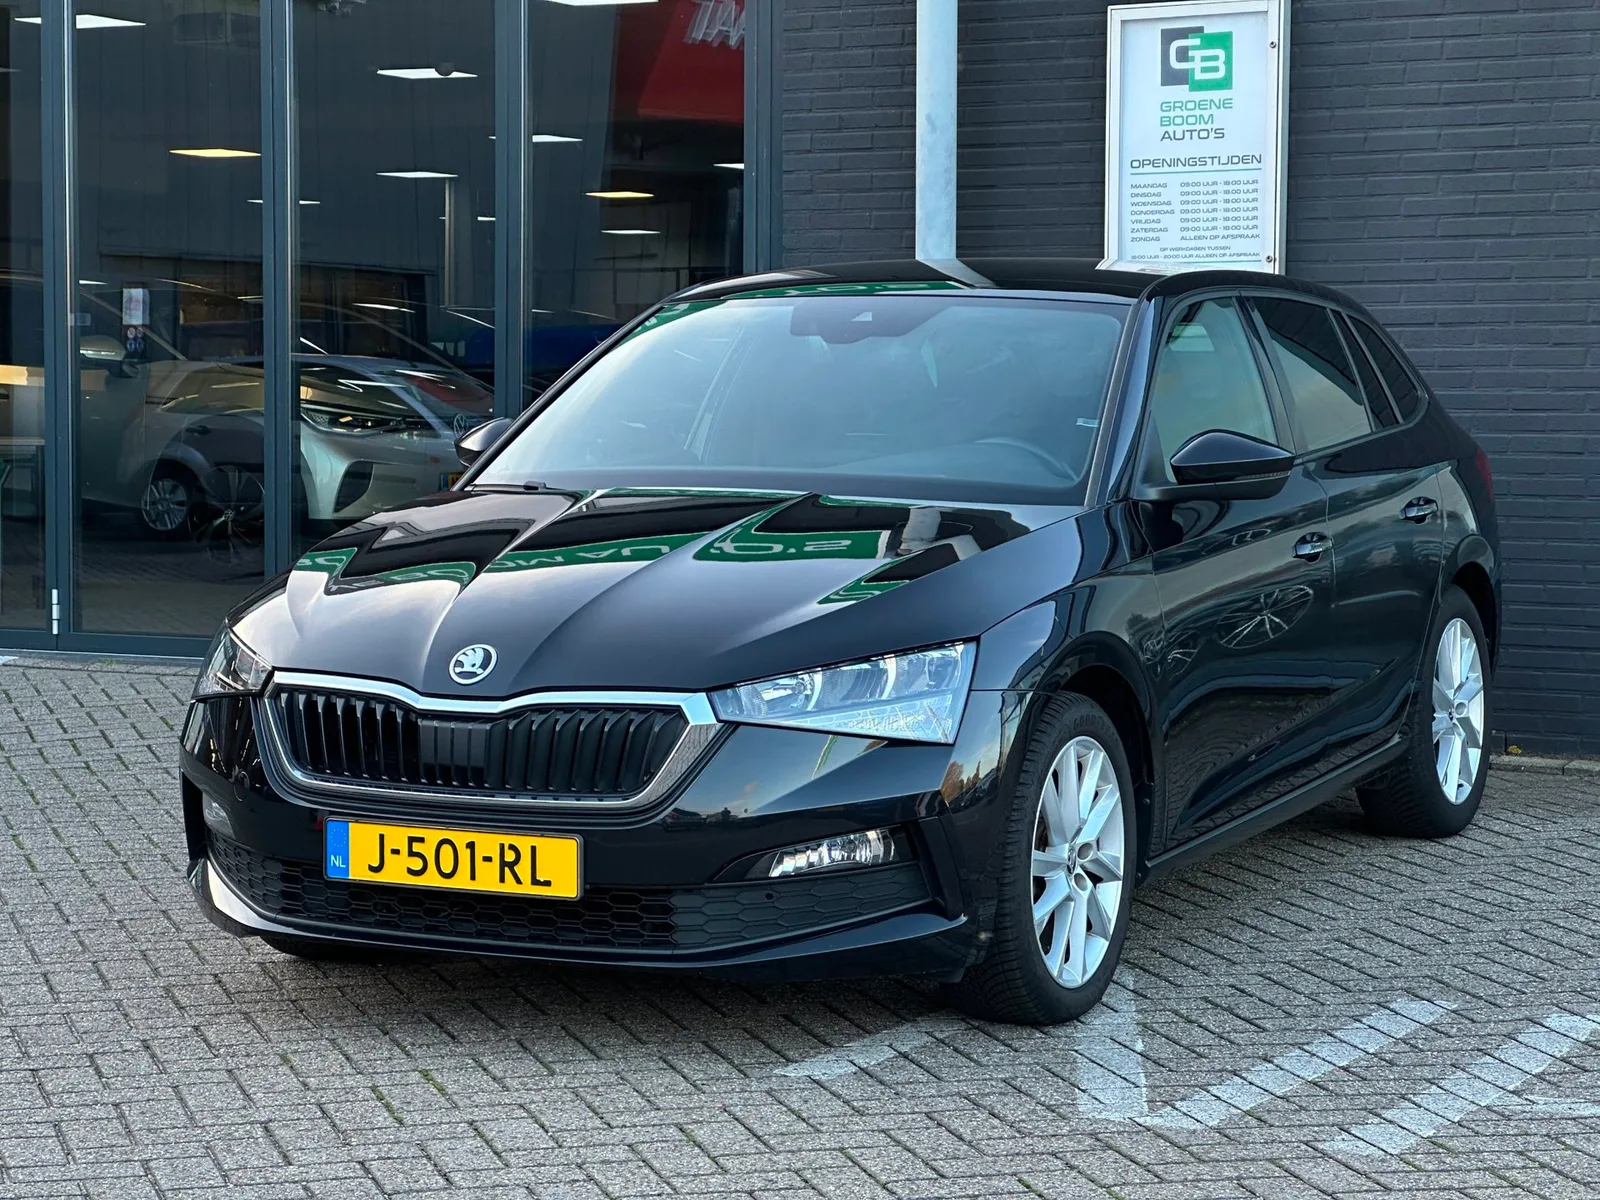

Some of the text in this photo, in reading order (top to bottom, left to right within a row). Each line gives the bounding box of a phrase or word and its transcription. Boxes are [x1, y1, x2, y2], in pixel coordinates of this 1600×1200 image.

[1160, 98, 1233, 112] GROENE
[1160, 114, 1214, 127] BOOM
[1160, 128, 1225, 141] AUTO'S
[1130, 154, 1262, 169] OPENINGSTIJDEN
[330, 854, 346, 868] NL
[367, 833, 552, 887] J-501-RL
